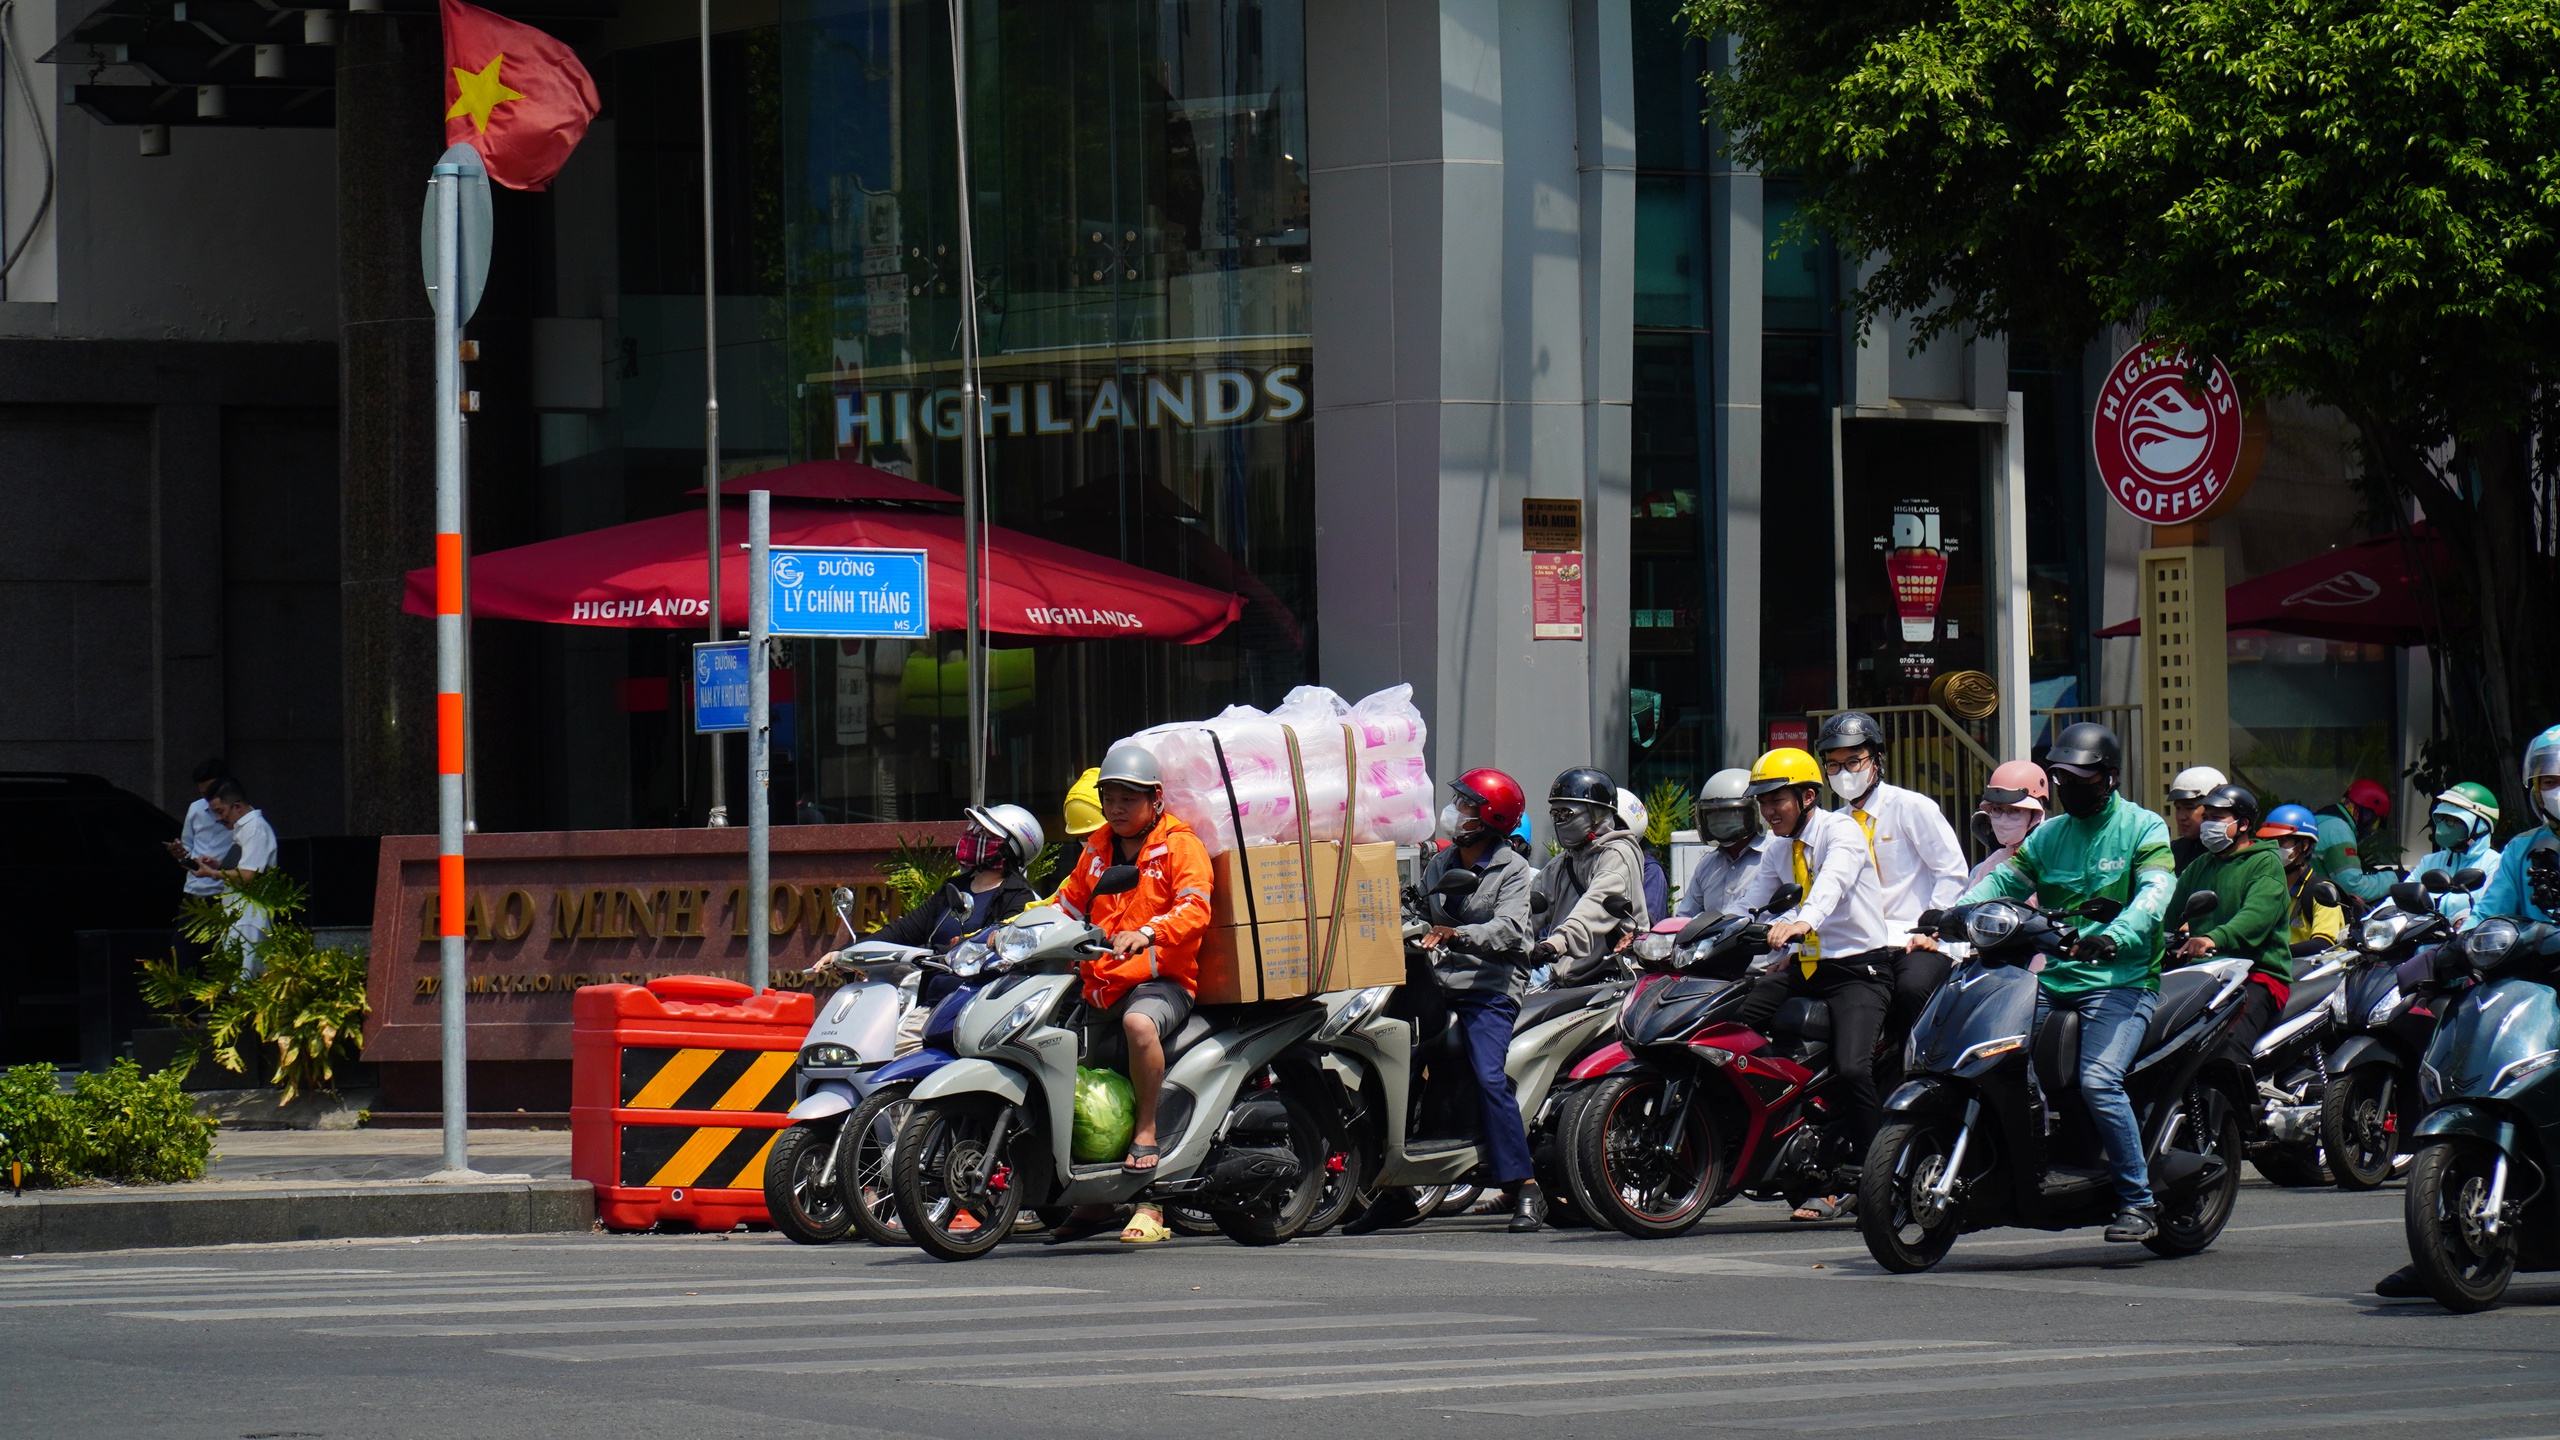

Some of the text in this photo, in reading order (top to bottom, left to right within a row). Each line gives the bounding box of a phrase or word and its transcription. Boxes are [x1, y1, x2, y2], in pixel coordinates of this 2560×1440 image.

[834, 365, 1307, 447] HIGHLANDS
[2119, 468, 2219, 515] COFFEE
[1551, 515, 1576, 527] MINH
[818, 556, 875, 577] ĐƯỜNG
[784, 582, 911, 615] LÝ CHÍNH THẮNG
[572, 598, 710, 620] HIGHLANDS
[1025, 607, 1143, 628] HIGHLANDS
[894, 620, 911, 631] MS
[714, 652, 737, 671] ĐƯỜNG
[1785, 731, 1798, 740] THANH
[1270, 859, 1290, 867] PLASTIC
[2098, 857, 2126, 871] Grab
[2136, 873, 2168, 915] Grab
[550, 886, 710, 940] MINH
[1374, 1026, 1398, 1036] SPORTY
[1037, 1036, 1064, 1047] SPORTY
